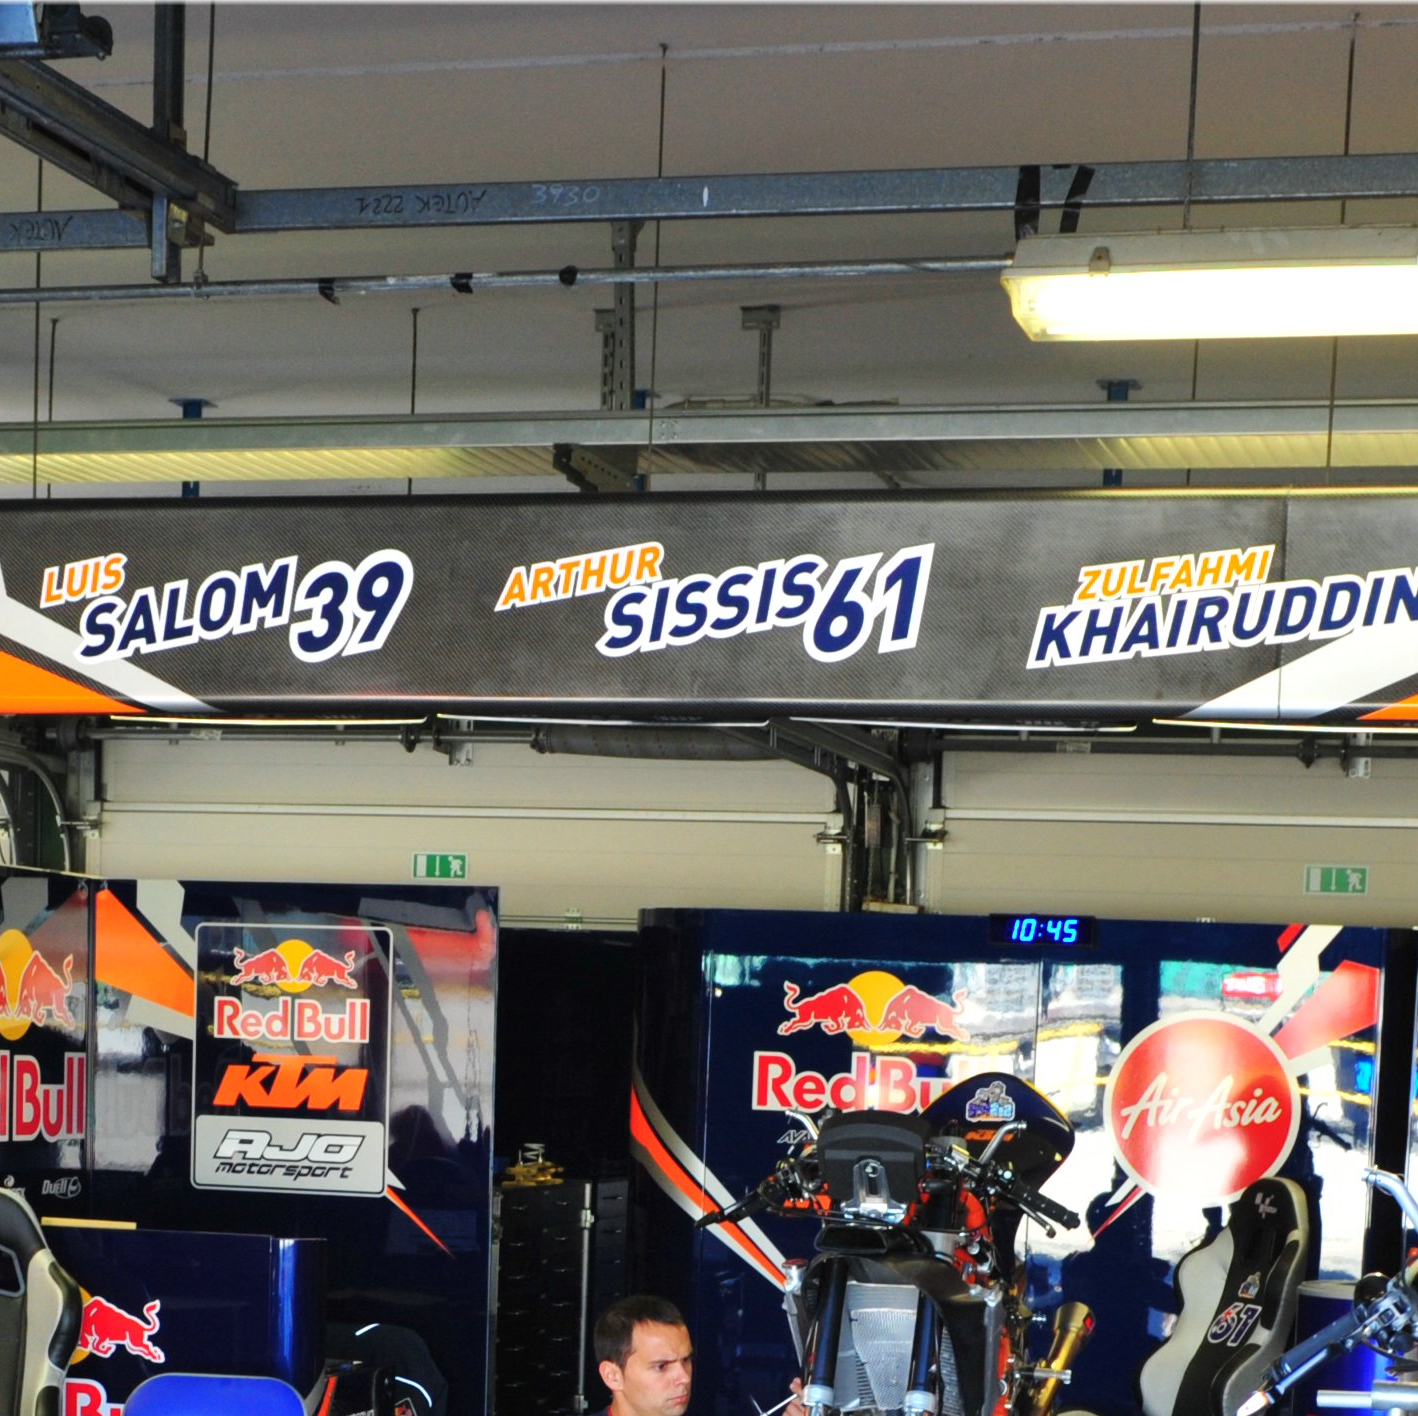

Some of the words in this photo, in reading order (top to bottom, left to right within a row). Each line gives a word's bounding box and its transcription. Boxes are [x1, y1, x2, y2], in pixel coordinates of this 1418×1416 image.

[43, 557, 124, 604] LUIS
[501, 544, 664, 610] ARTHUR
[1076, 548, 1271, 602] ZULFAHMI
[79, 560, 290, 658] SALOM
[293, 552, 409, 657] 39
[599, 562, 813, 651] SISSIS
[807, 551, 928, 657] 61
[1011, 918, 1079, 943] 10:45
[214, 996, 291, 1041] Red
[294, 998, 370, 1043] Bull
[12, 1052, 86, 1142] Bull
[213, 1050, 368, 1112] KTM
[752, 1050, 871, 1113] Red
[213, 1128, 366, 1166] AJO
[215, 1161, 353, 1182] motorsport
[1207, 1301, 1263, 1348] 61
